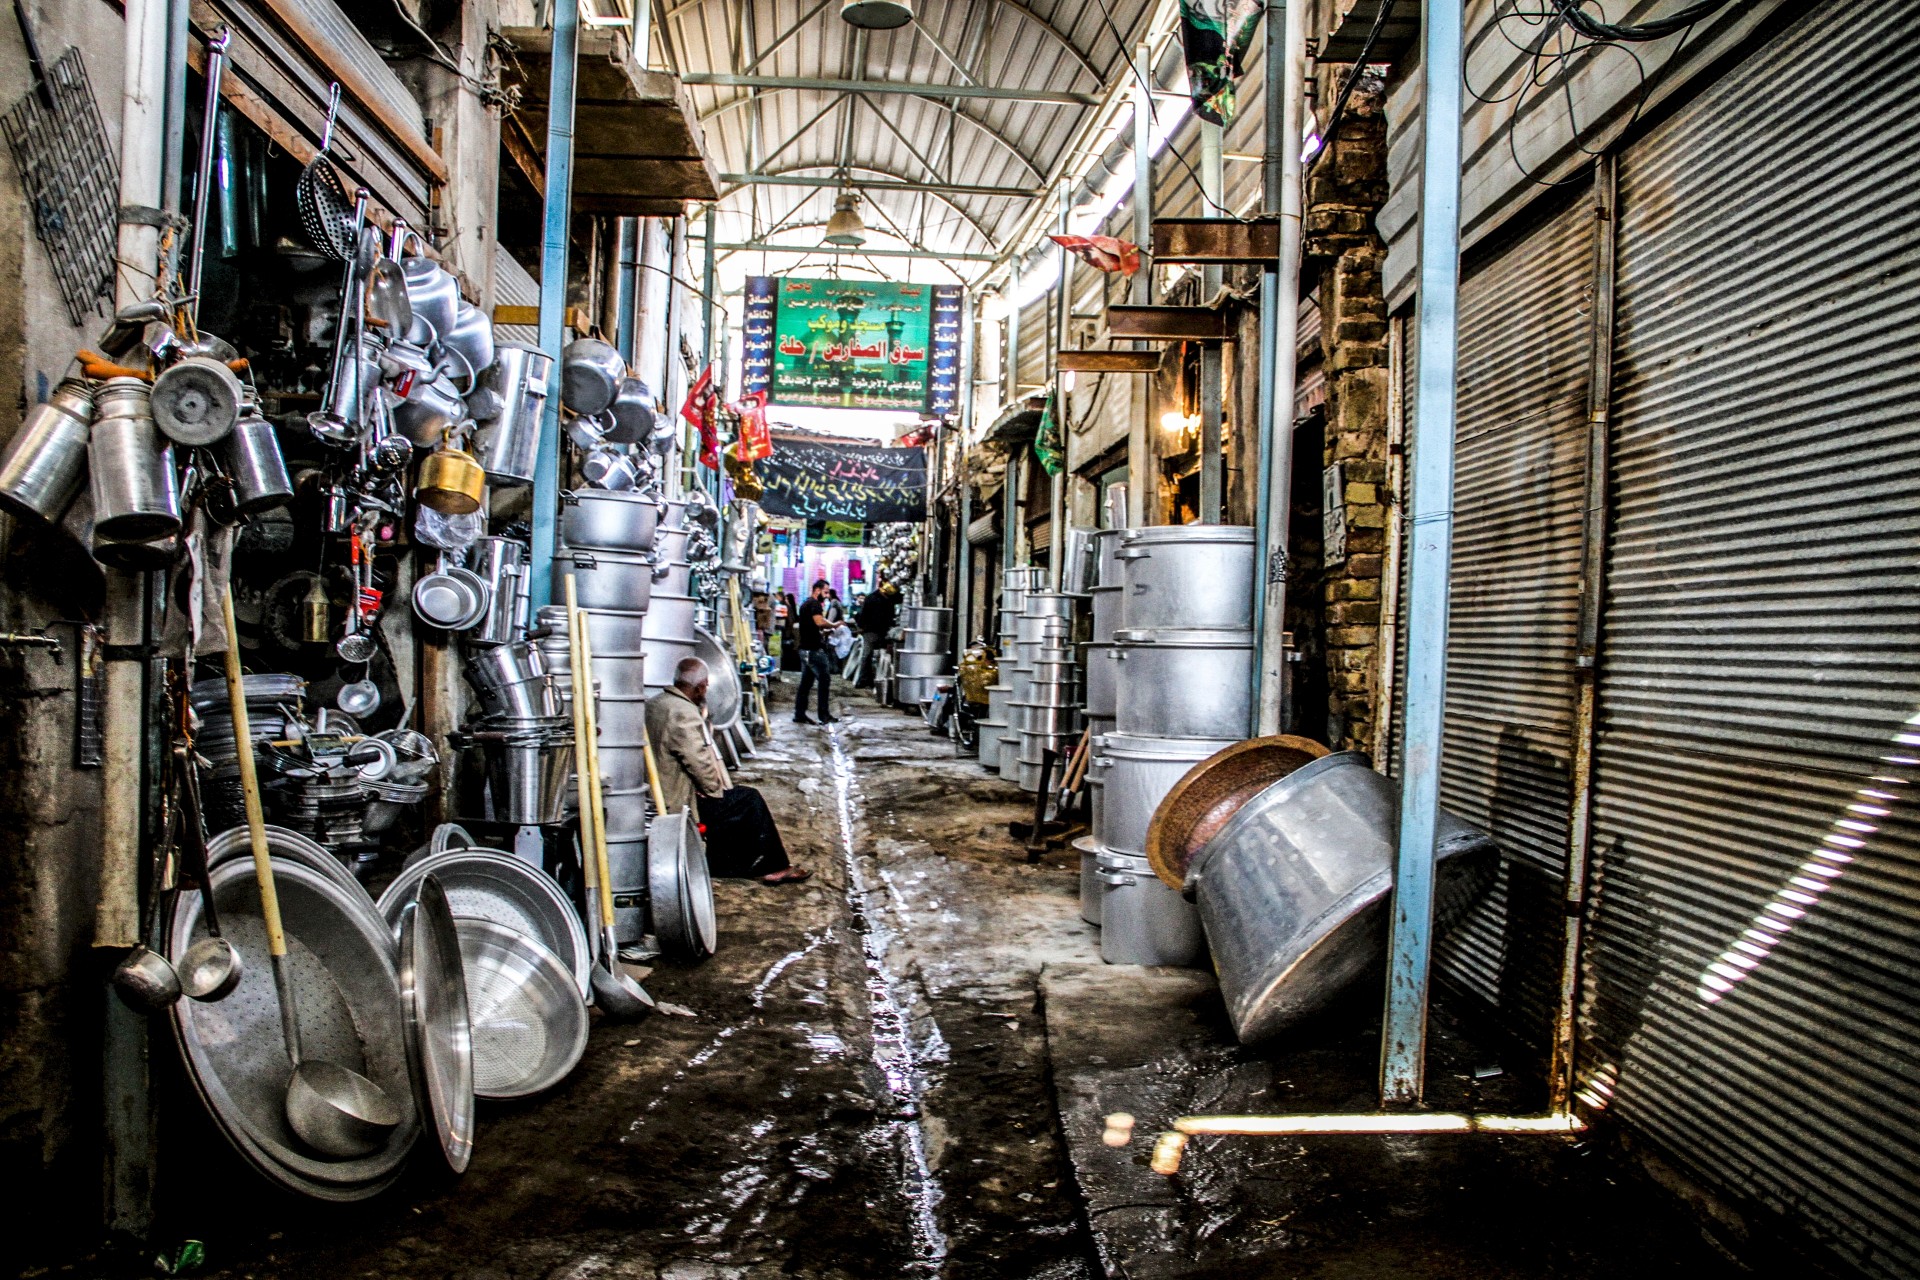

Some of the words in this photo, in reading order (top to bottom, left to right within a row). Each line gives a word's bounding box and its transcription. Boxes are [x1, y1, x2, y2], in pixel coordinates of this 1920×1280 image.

[748, 294, 773, 305] الصادق
[747, 309, 773, 320] الكاظم
[935, 304, 959, 312] محمد
[746, 325, 772, 336] الرضا
[807, 314, 848, 334] وموكب
[849, 319, 886, 334] مسجد
[934, 319, 958, 332] علي
[934, 331, 958, 342] فاطمة
[745, 340, 771, 351] الجواد
[778, 333, 806, 355] حلة
[822, 339, 887, 362] الصفارين
[808, 341, 819, 364] /
[889, 339, 925, 365] سوق
[744, 358, 770, 370] الهادي
[743, 373, 770, 386] العسكري
[931, 396, 955, 409] الباقر
